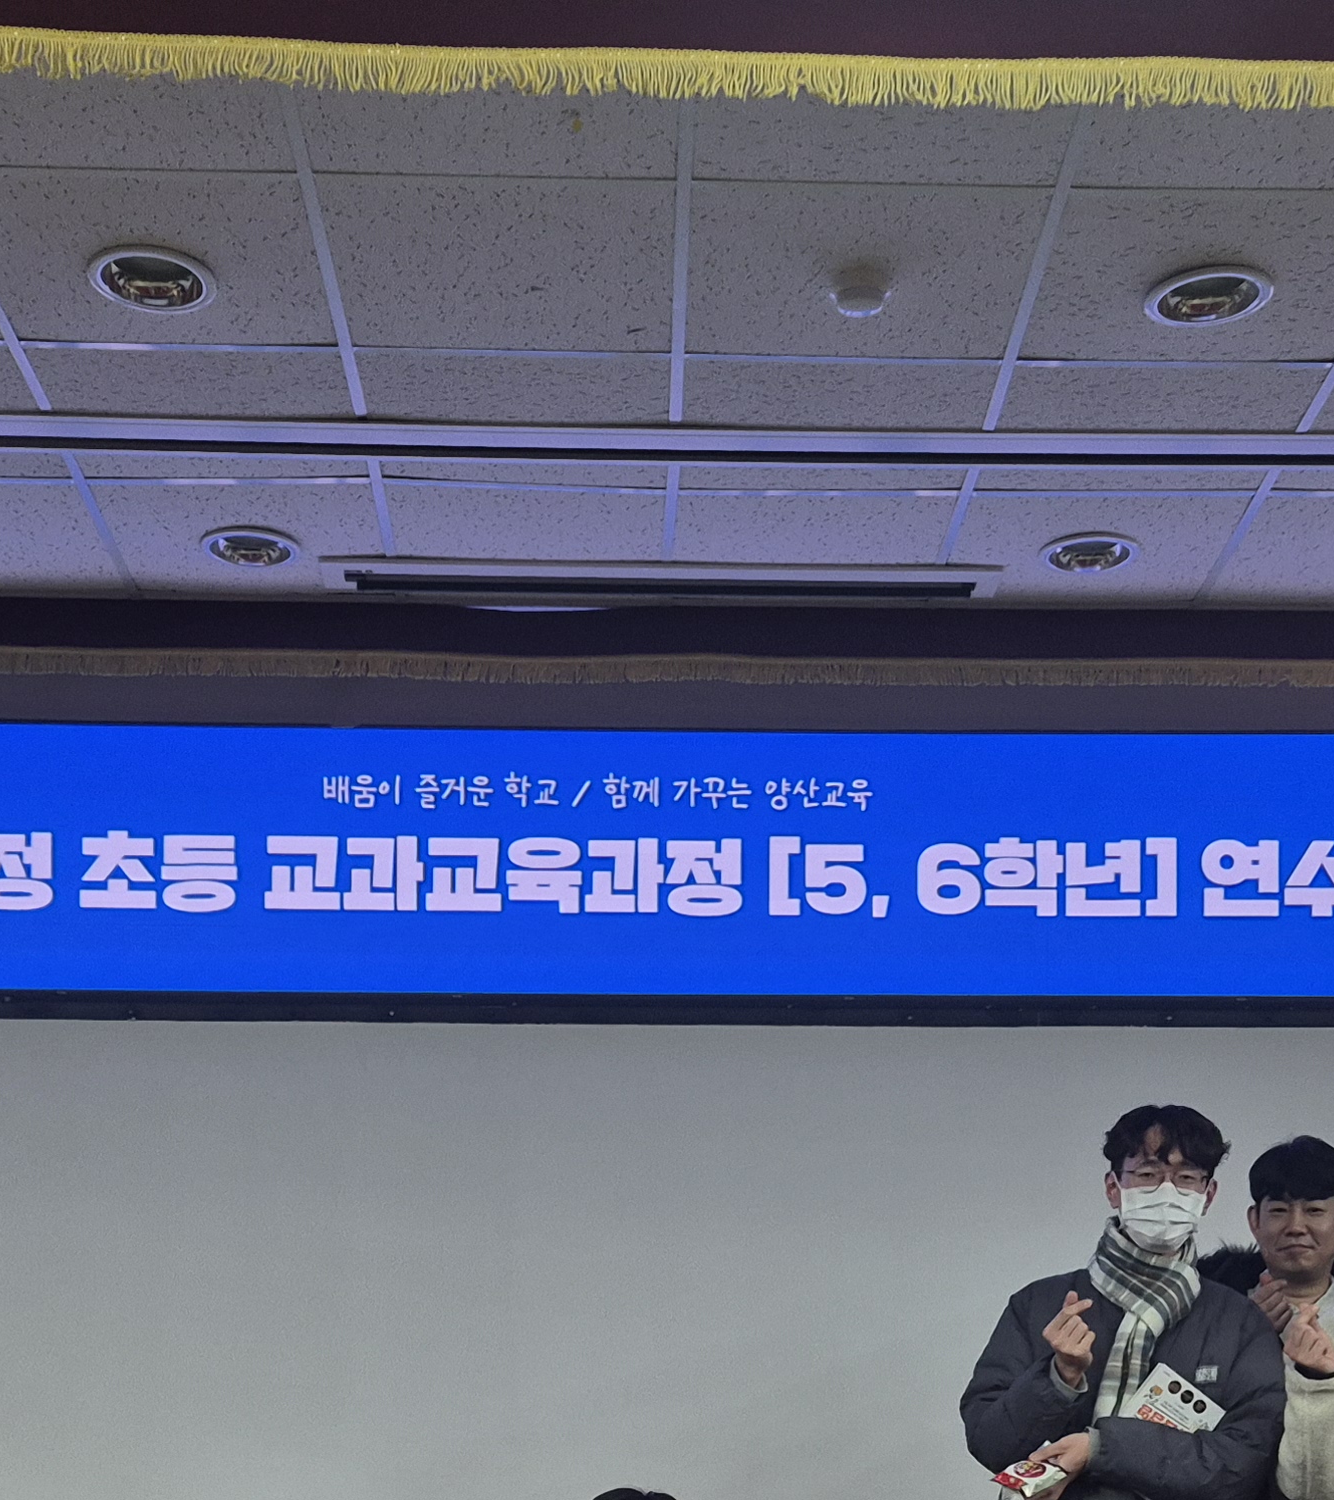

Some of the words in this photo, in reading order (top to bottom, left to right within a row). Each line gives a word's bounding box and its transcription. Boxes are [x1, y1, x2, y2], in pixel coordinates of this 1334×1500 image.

[323, 774, 401, 805] 배움이
[414, 774, 493, 809] 즐거운
[504, 772, 559, 808] 학교
[603, 773, 660, 809] 함께
[673, 777, 753, 809] 가꾸는
[765, 776, 873, 811] 양산교육
[79, 830, 238, 913] 초등
[264, 835, 743, 917] 교과교육과정
[768, 836, 890, 918] [5,
[916, 837, 1178, 918] 6학년]
